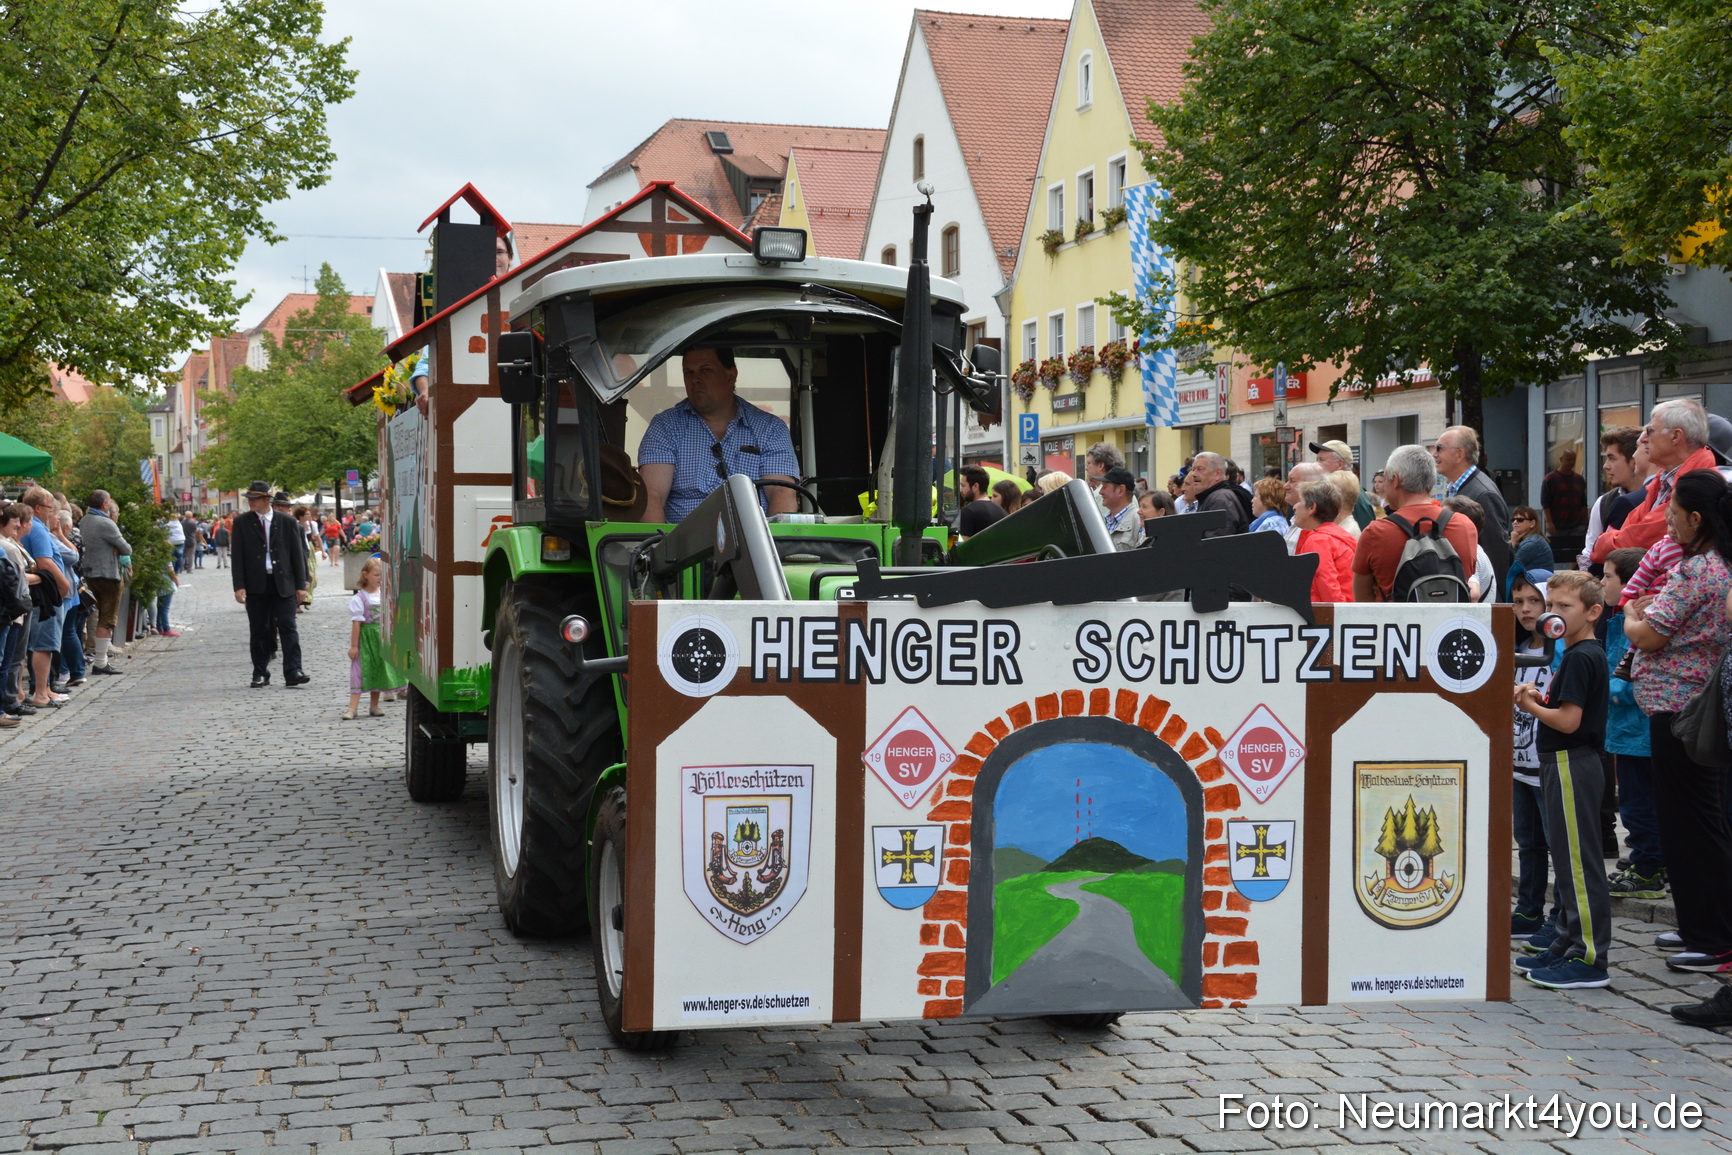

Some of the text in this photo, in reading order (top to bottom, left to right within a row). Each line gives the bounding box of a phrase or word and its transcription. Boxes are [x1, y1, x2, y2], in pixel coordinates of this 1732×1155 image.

[1196, 388, 1209, 401] KINO
[1219, 366, 1227, 419] KINO
[1023, 416, 1035, 440] P
[751, 616, 1421, 685] HENGER SCHÜTZEN
[869, 747, 952, 763] 19 HENGER 63
[1223, 743, 1301, 760] 19 HENGER 63
[1513, 750, 1531, 762] AL
[898, 762, 923, 778] SV
[1250, 758, 1274, 774] SV
[688, 769, 805, 795] Böllerschützen
[1256, 785, 1269, 795] eV
[903, 790, 917, 800] eV
[727, 913, 767, 936] Heng
[682, 993, 810, 1014] www.henger-sv.de/schuetzen
